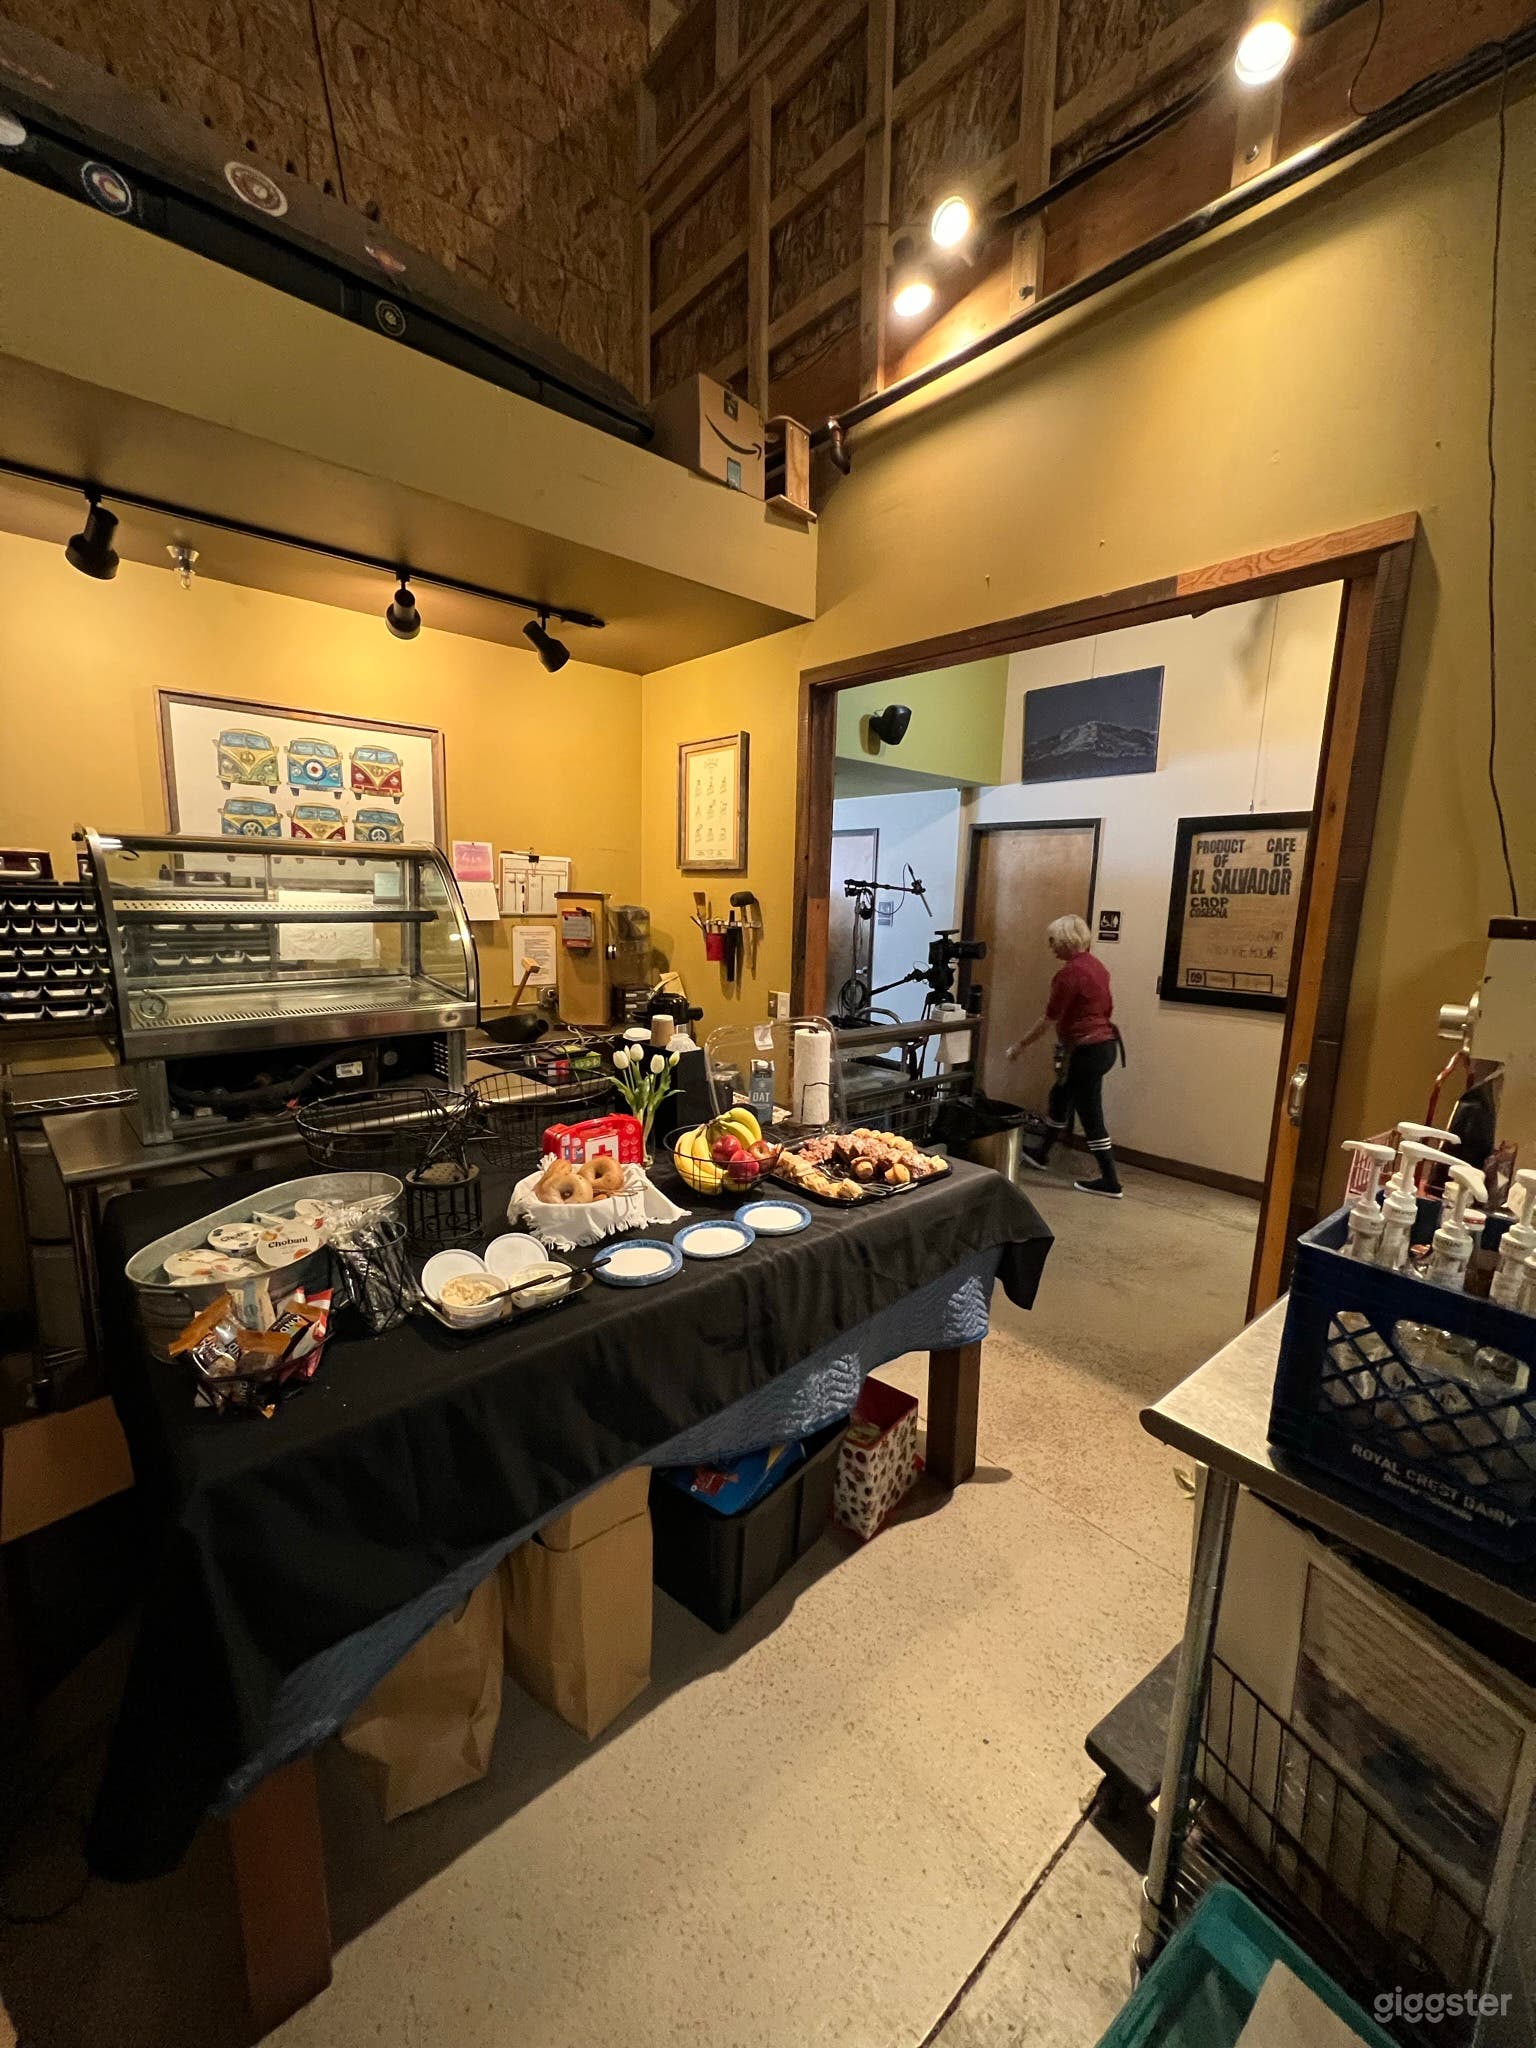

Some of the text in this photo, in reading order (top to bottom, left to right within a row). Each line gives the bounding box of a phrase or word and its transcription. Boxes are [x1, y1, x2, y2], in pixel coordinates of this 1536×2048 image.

[1196, 840, 1246, 854] PRODUCT
[1267, 838, 1296, 853] CAFE
[1213, 854, 1229, 868] OF
[1273, 853, 1290, 867] DE
[1190, 867, 1292, 896] EL SALVADOR
[1190, 897, 1229, 908] CROP
[1189, 908, 1228, 919] COSECHA
[752, 1092, 771, 1102] OAT
[268, 1236, 309, 1249] Chobani
[1352, 1442, 1400, 1475] ROYAL
[1407, 1469, 1459, 1501] CREST
